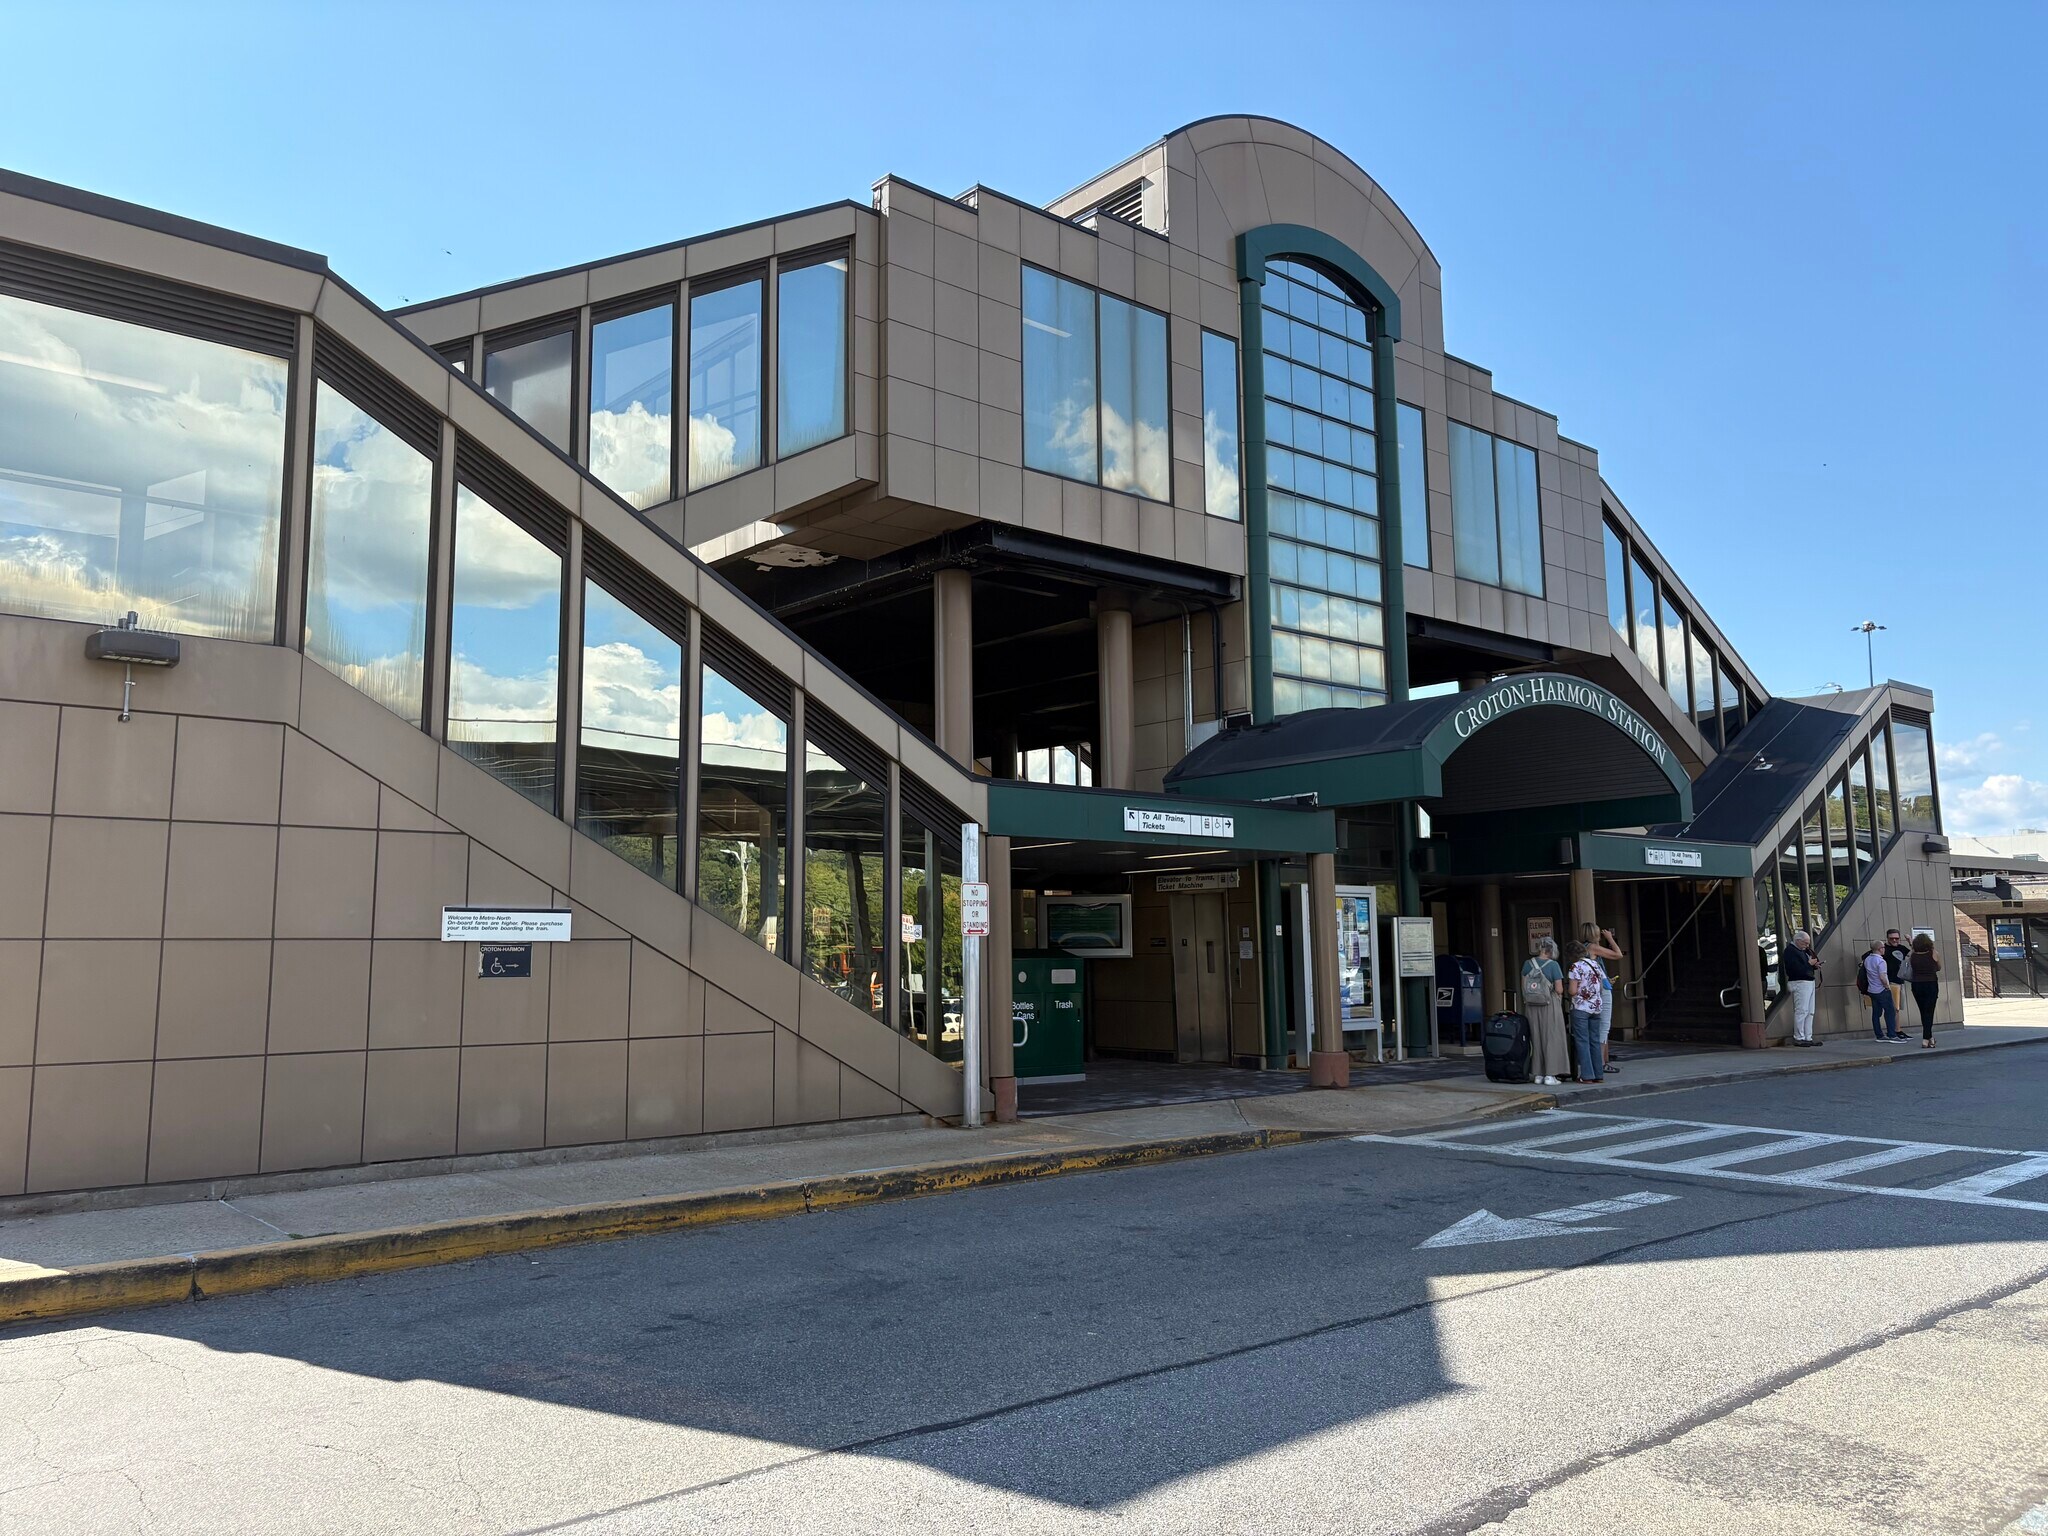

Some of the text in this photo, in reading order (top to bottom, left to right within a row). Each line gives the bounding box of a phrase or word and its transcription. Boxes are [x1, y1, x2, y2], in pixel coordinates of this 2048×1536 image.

[1454, 677, 1667, 766] CROTON-HARMON STATION
[1142, 812, 1150, 820] To
[1165, 814, 1186, 824] Trains,
[1142, 822, 1166, 831] Tickets
[1157, 876, 1182, 884] Elevator
[1157, 882, 1204, 891] Ticket Machine
[970, 889, 979, 897] NO
[962, 899, 988, 907] STOPPING
[971, 910, 980, 918] OR
[962, 921, 988, 929] STANDING
[1529, 921, 1552, 930] ELEVATOR
[1054, 1000, 1074, 1009] Trash
[1016, 1011, 1035, 1020] Cans
